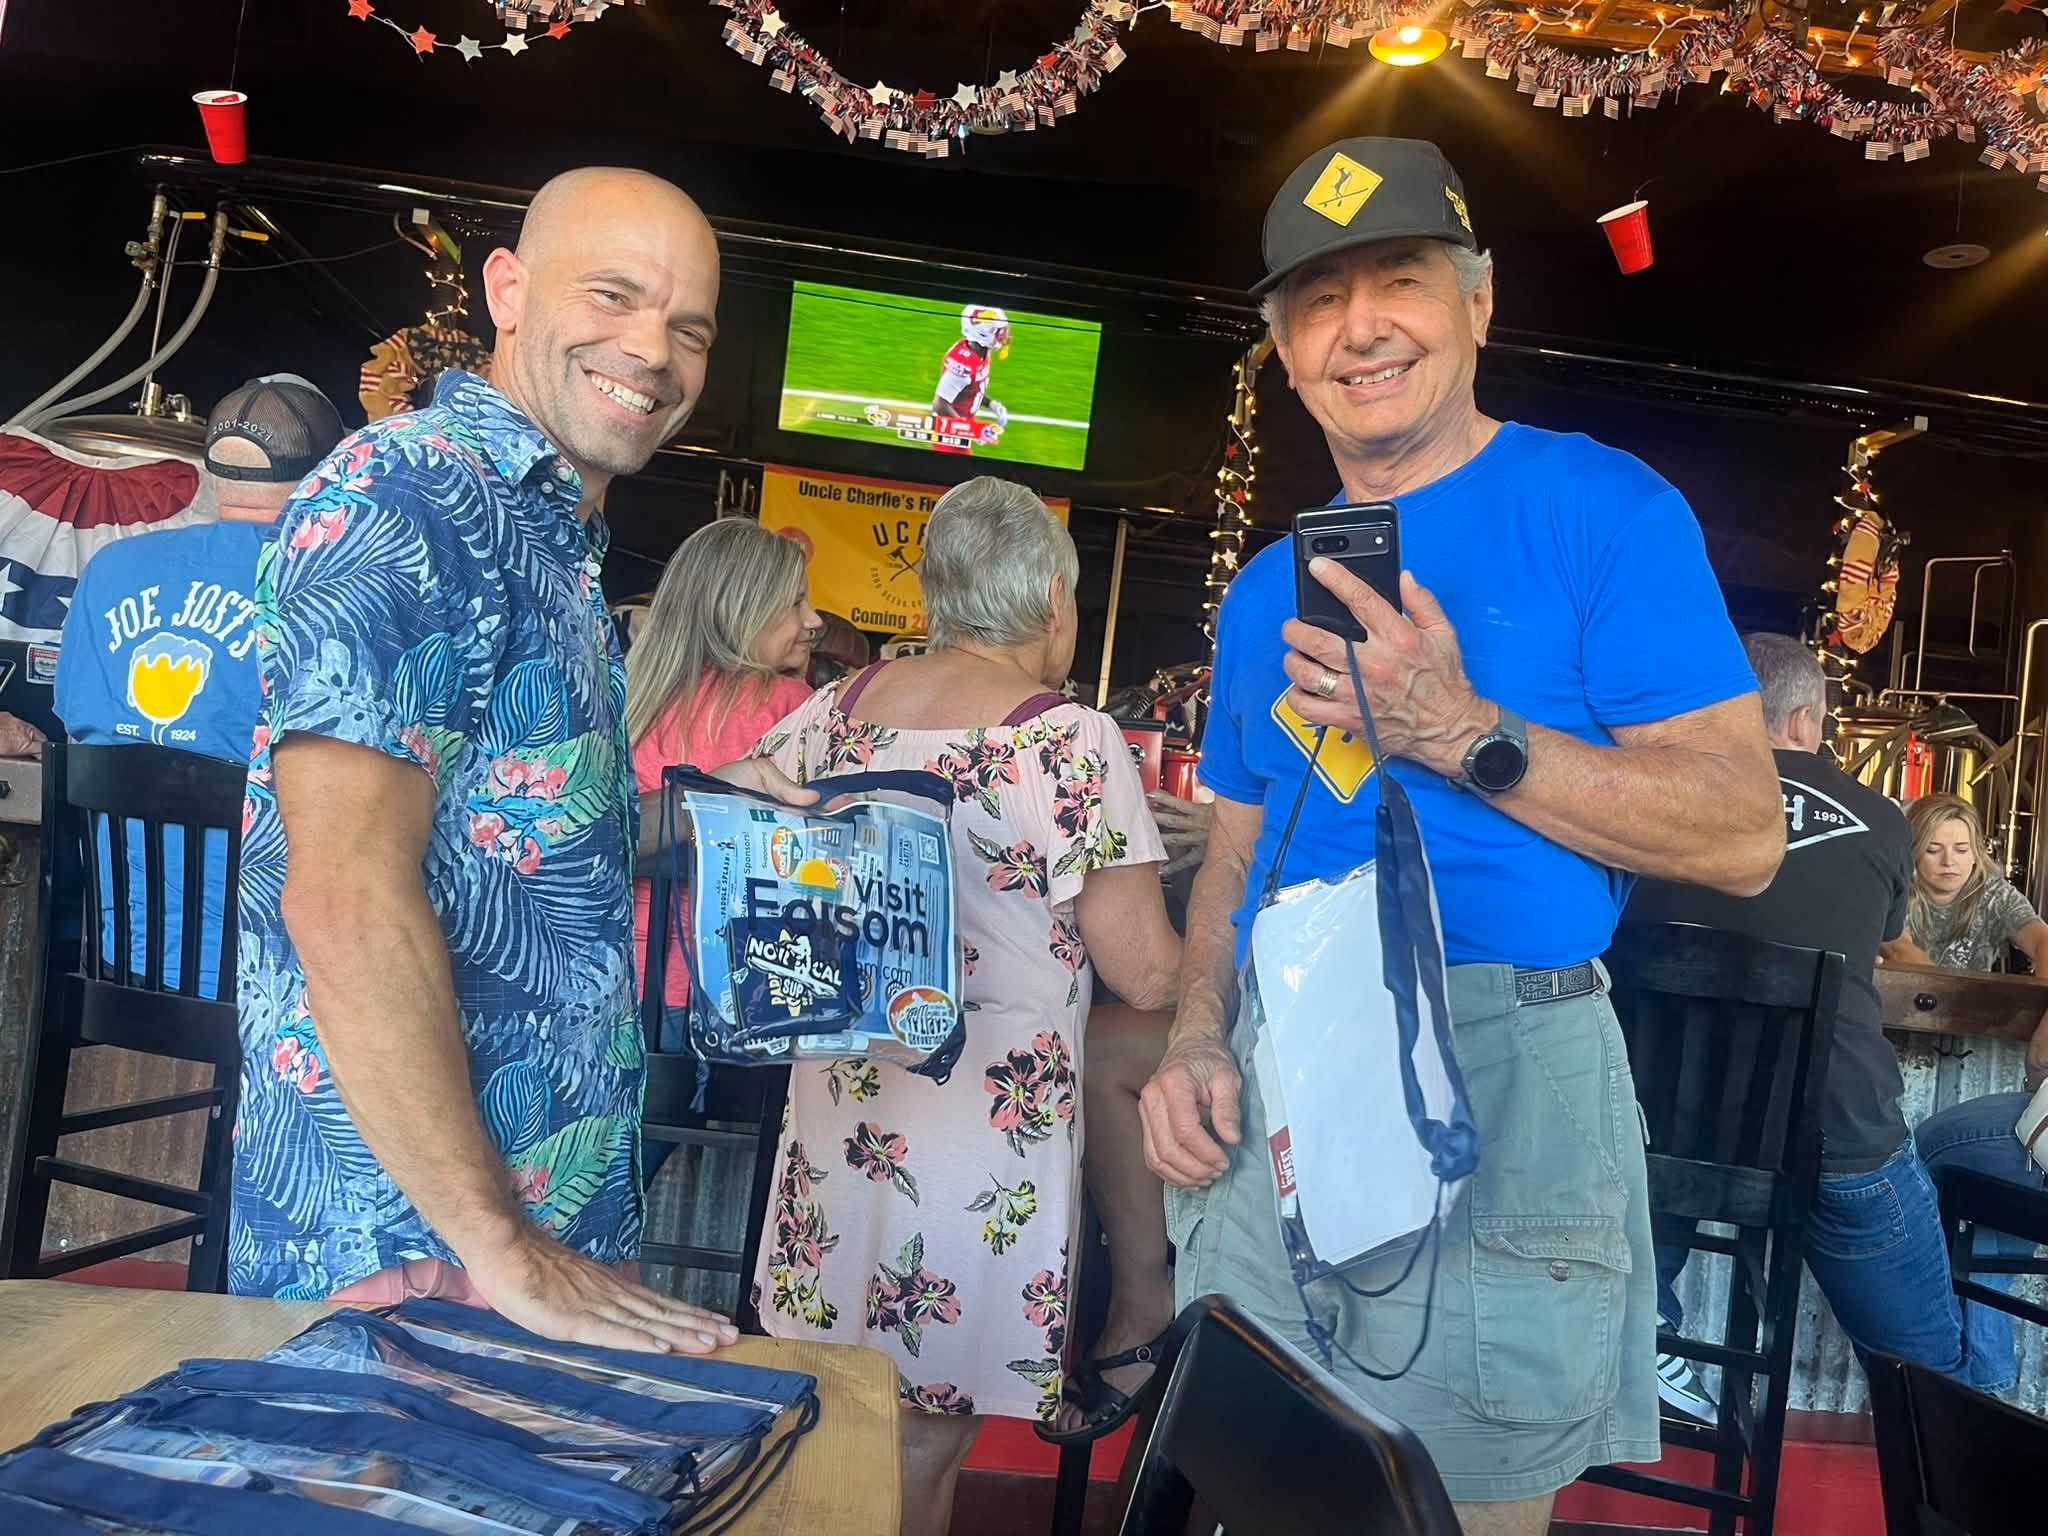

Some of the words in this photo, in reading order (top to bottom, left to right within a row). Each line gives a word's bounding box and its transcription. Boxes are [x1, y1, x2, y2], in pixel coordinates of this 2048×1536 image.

[798, 480, 842, 501] Uncle
[847, 487, 915, 511] Charlie's
[104, 584, 162, 655] JOE
[851, 607, 907, 630] Coming
[115, 723, 141, 737] EST.
[169, 728, 197, 742] 1924
[1813, 810, 1847, 825] 1991
[853, 870, 927, 918] Visit
[746, 877, 929, 957] Folsom
[812, 961, 843, 987] CAL
[782, 978, 805, 999] SUP
